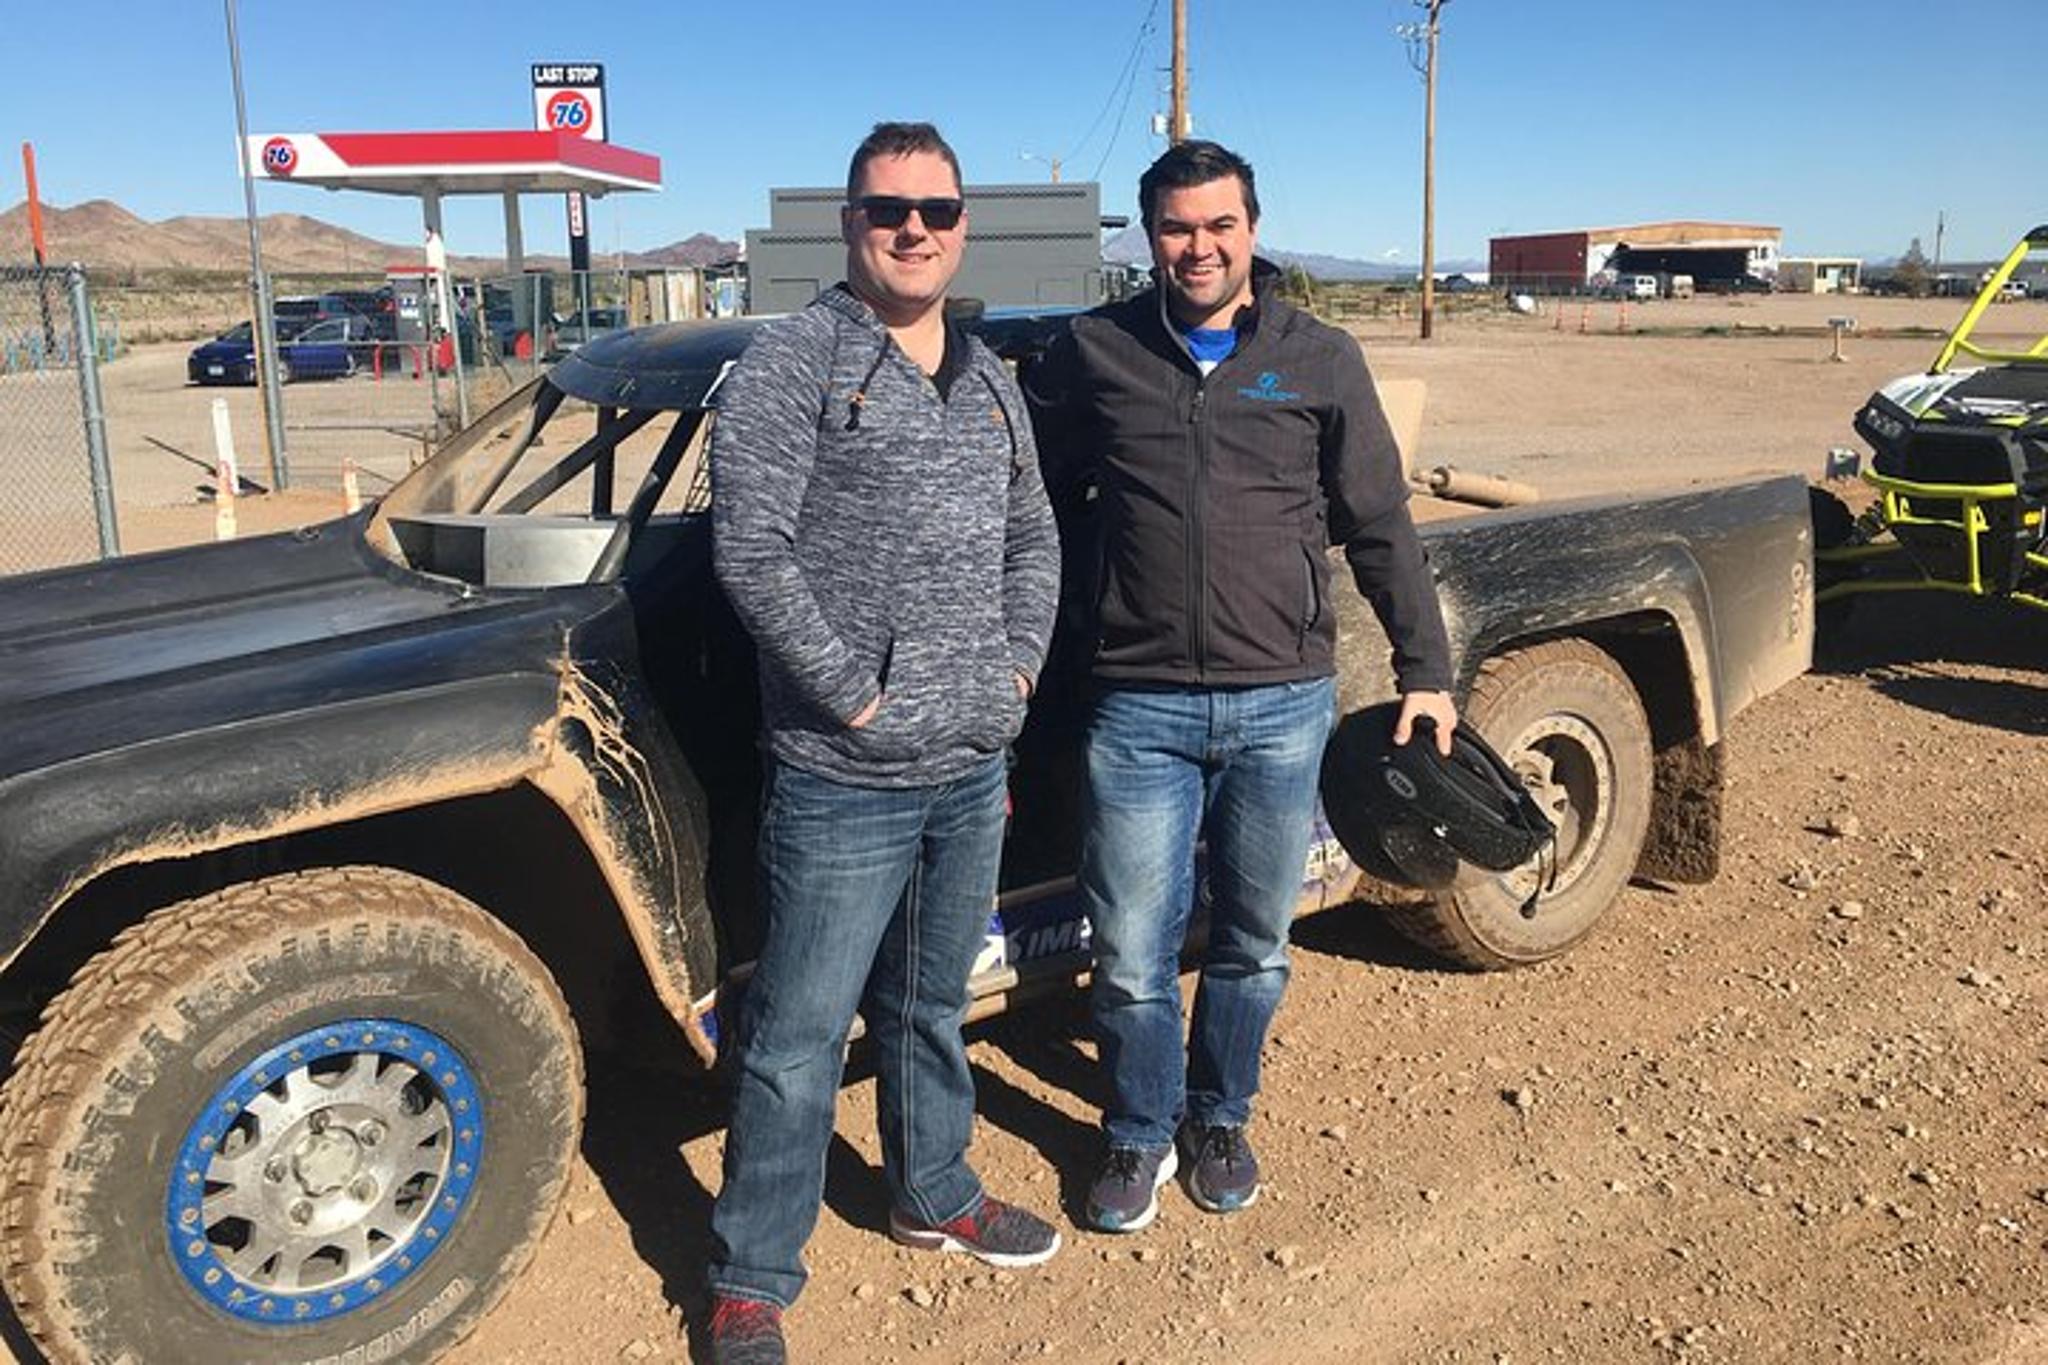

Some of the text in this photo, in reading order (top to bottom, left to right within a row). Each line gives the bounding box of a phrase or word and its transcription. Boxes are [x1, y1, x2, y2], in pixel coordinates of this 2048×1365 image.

[534, 67, 599, 83] LAST STOP
[555, 100, 585, 127] 76
[267, 142, 291, 158] 76
